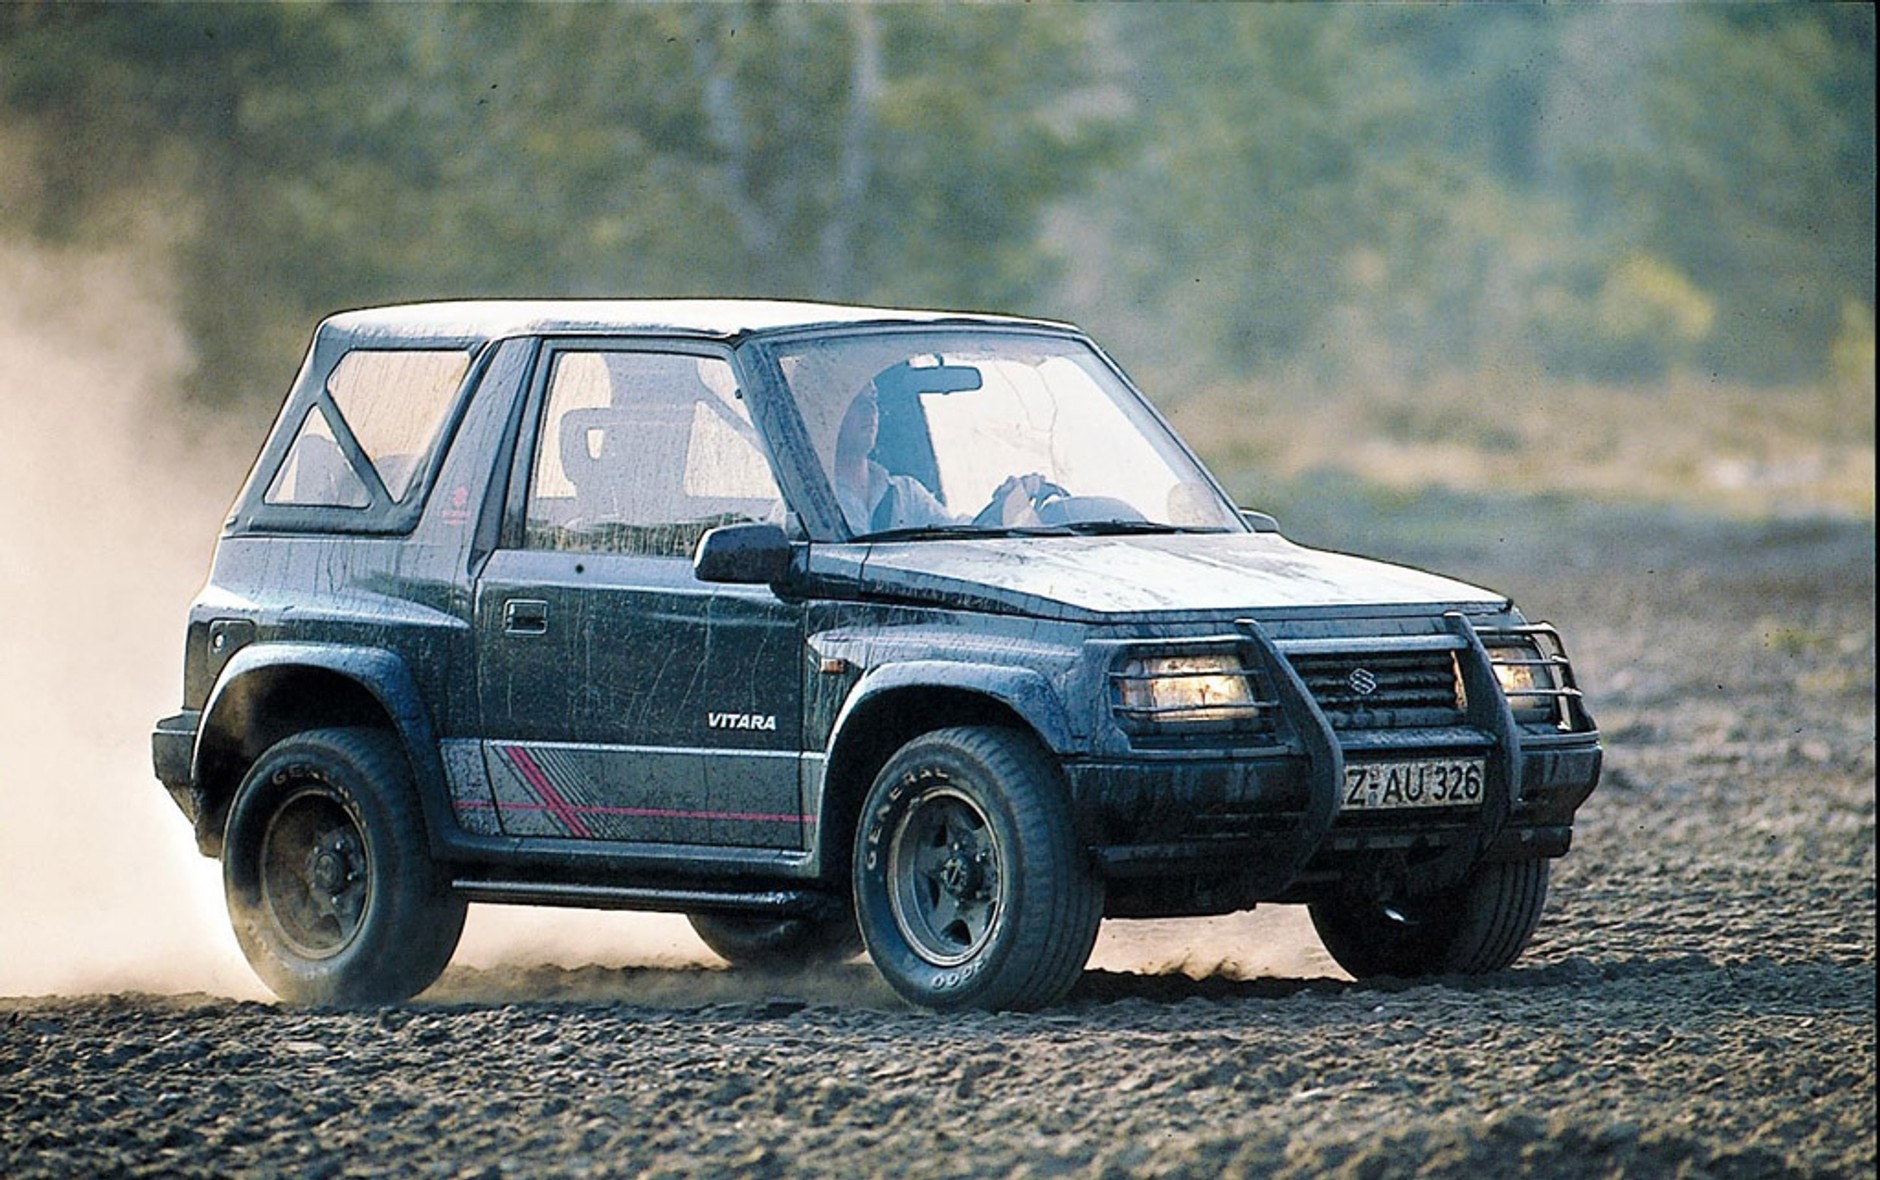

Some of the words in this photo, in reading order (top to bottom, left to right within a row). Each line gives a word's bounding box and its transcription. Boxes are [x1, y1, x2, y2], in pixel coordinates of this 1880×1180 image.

[708, 712, 777, 731] VITARA
[1343, 767, 1425, 805] Z-AU
[1433, 764, 1481, 801] 326
[867, 767, 949, 871] GENERAL
